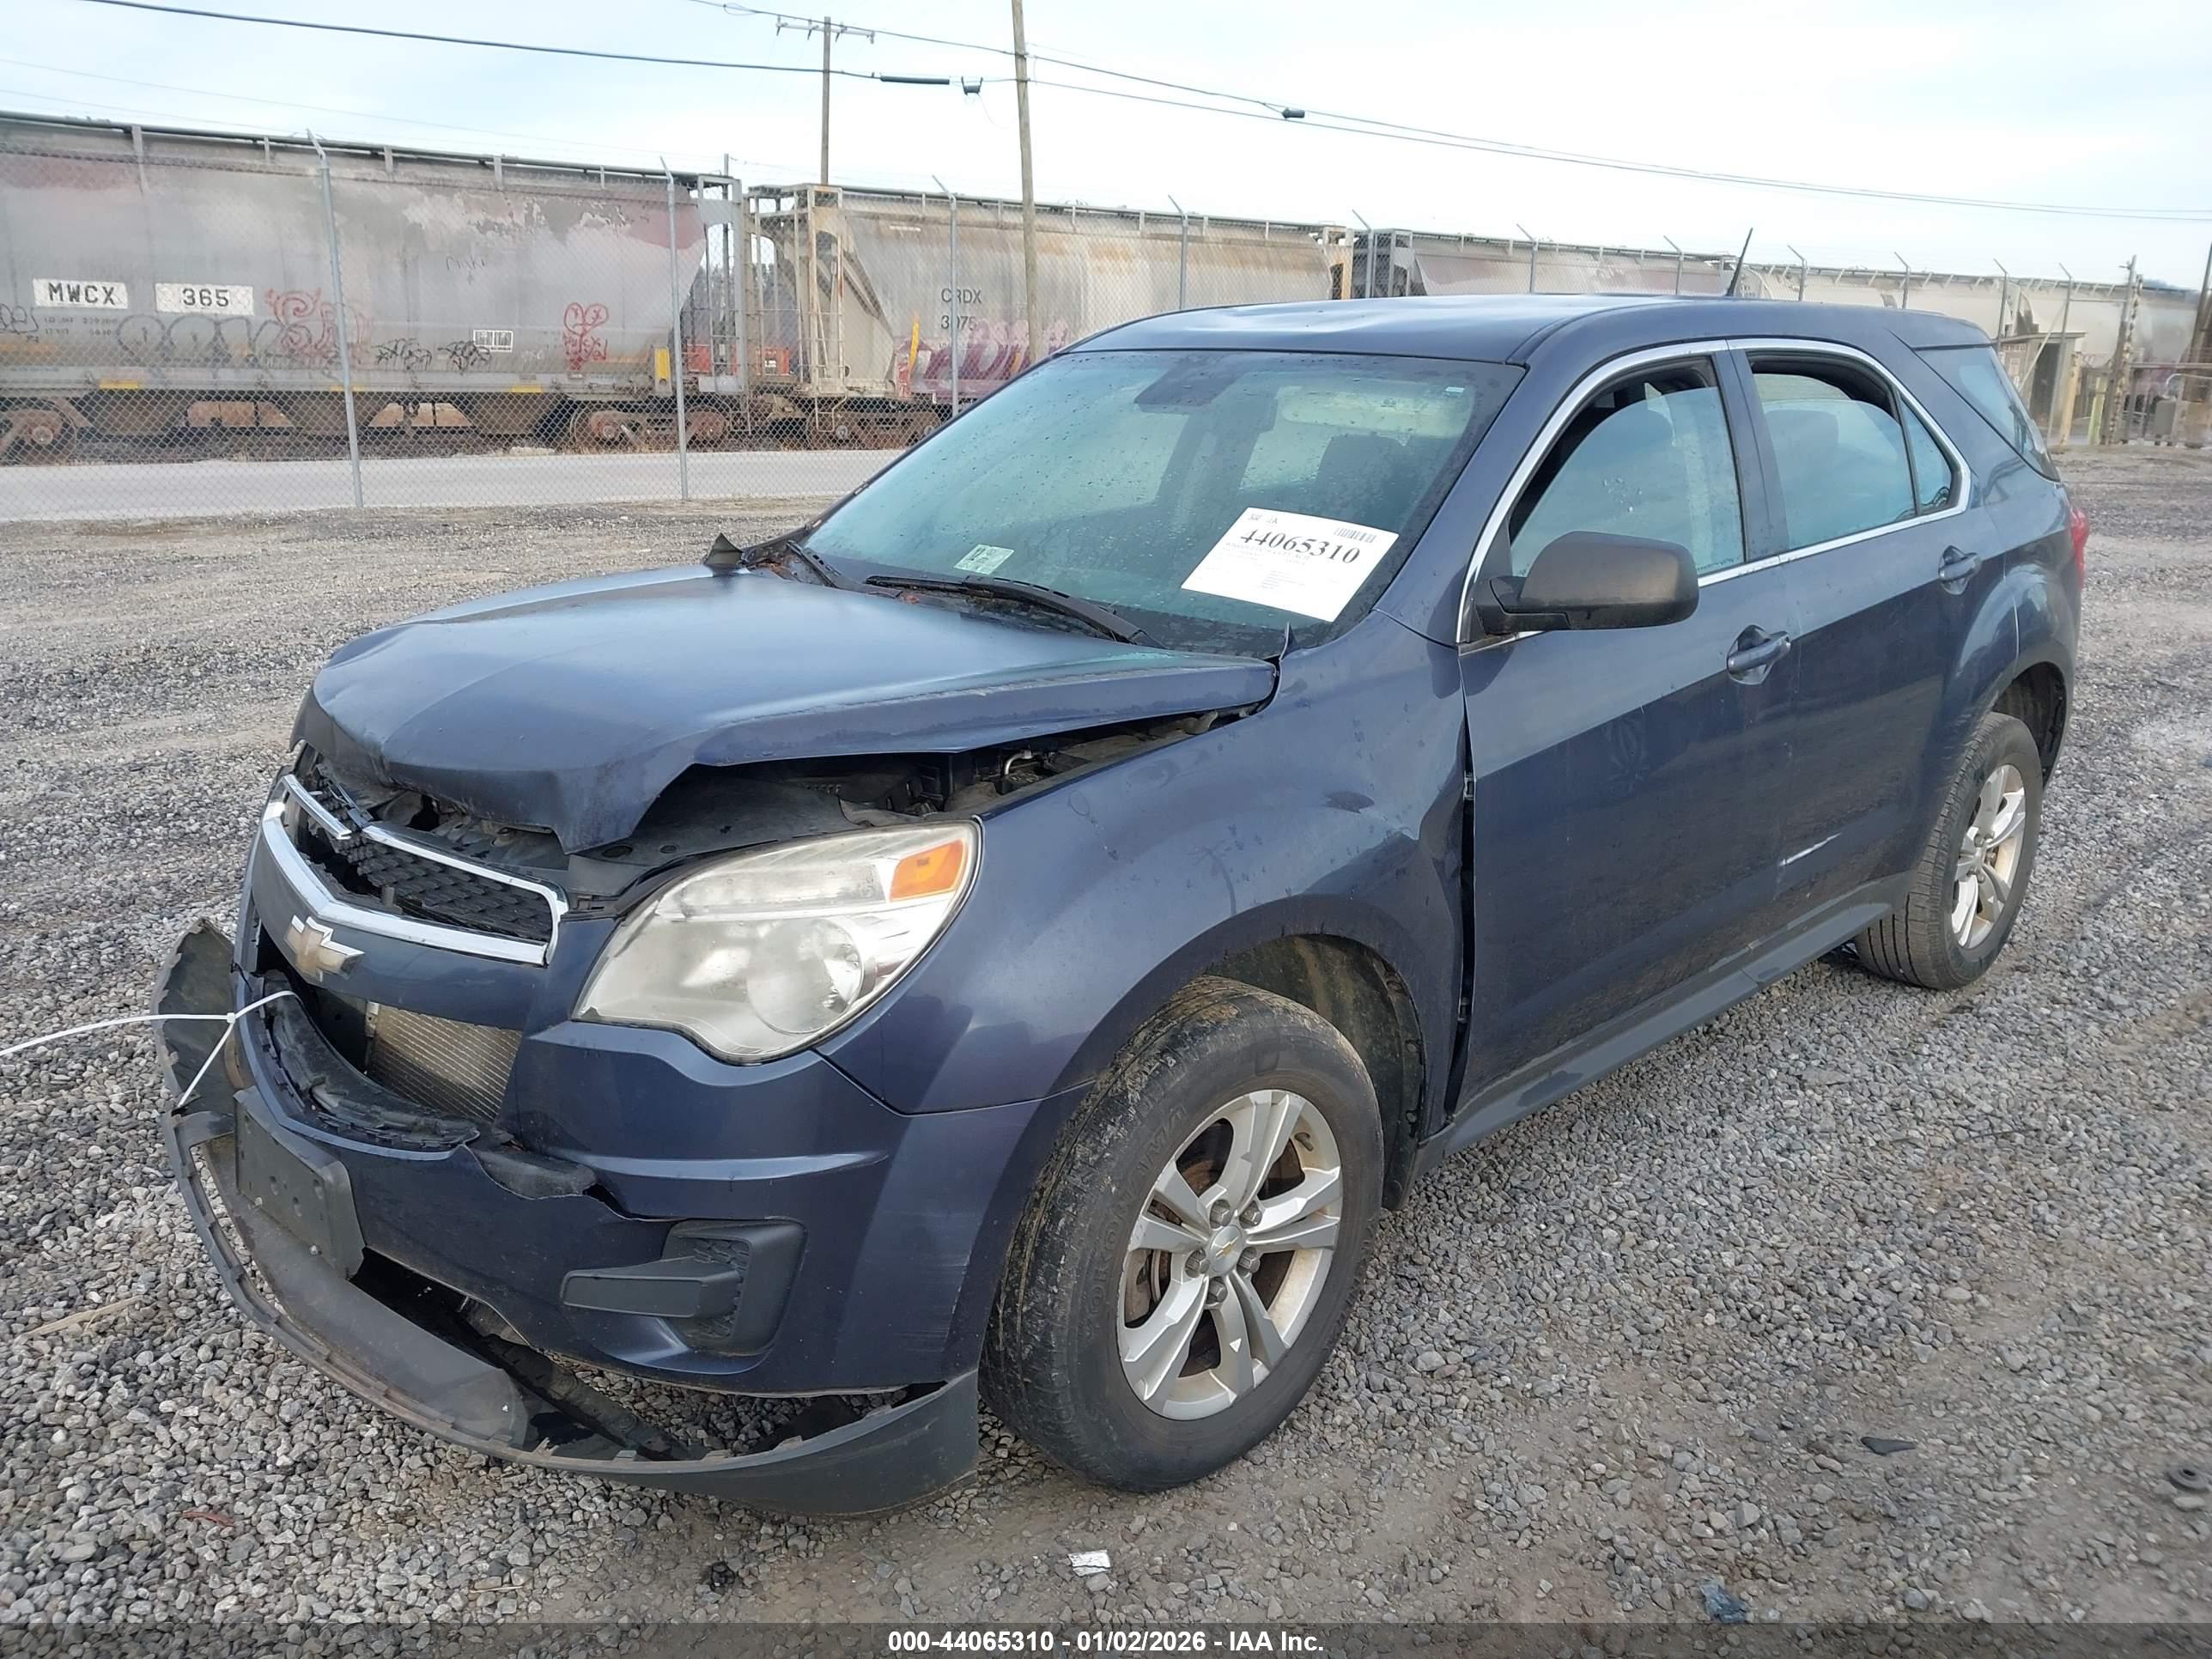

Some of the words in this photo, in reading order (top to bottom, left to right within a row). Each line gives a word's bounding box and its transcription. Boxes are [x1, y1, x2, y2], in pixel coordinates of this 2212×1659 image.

[48, 282, 116, 306] MWCX
[181, 288, 229, 307] 365
[941, 288, 982, 303] CRDX
[941, 314, 977, 331] 375
[1240, 528, 1361, 564] 44065310
